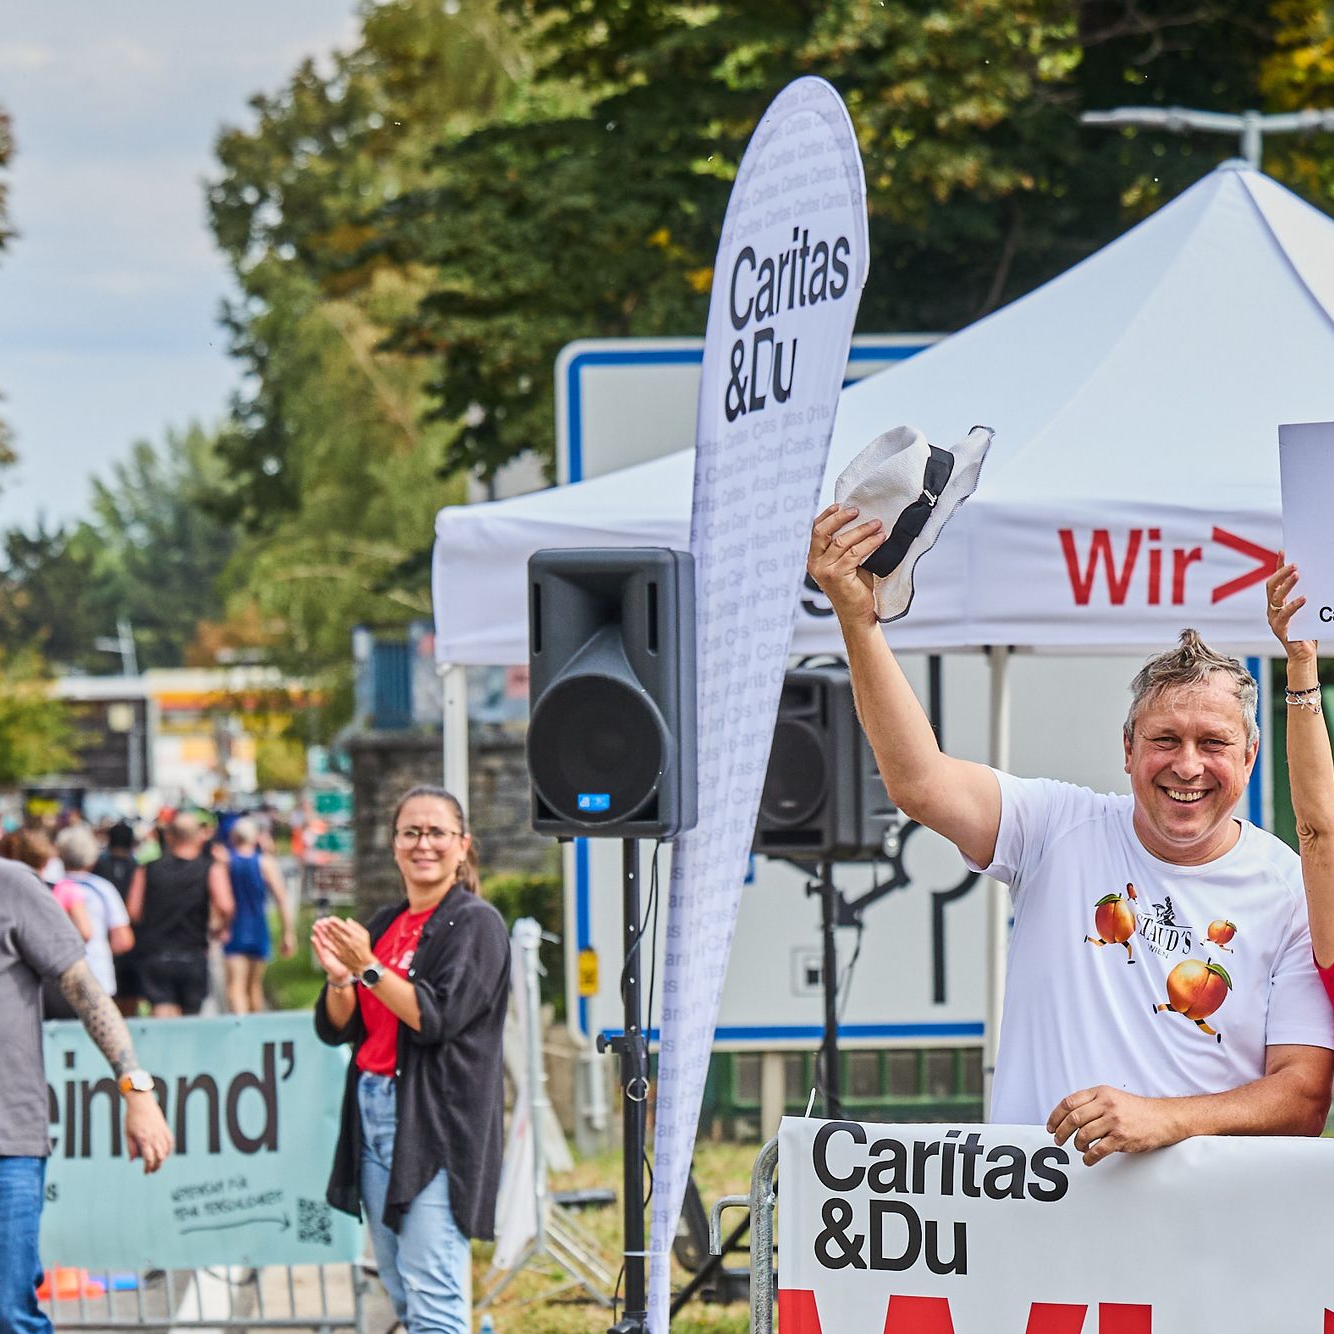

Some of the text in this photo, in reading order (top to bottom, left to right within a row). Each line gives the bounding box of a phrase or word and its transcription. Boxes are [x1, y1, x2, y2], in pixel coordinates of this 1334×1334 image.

[730, 227, 851, 331] Caritas
[725, 327, 797, 423] &Du
[1057, 526, 1281, 606] Wir>
[1137, 913, 1193, 955] STAUD'S
[812, 1121, 1069, 1202] Caritas
[814, 1198, 968, 1275] &Du
